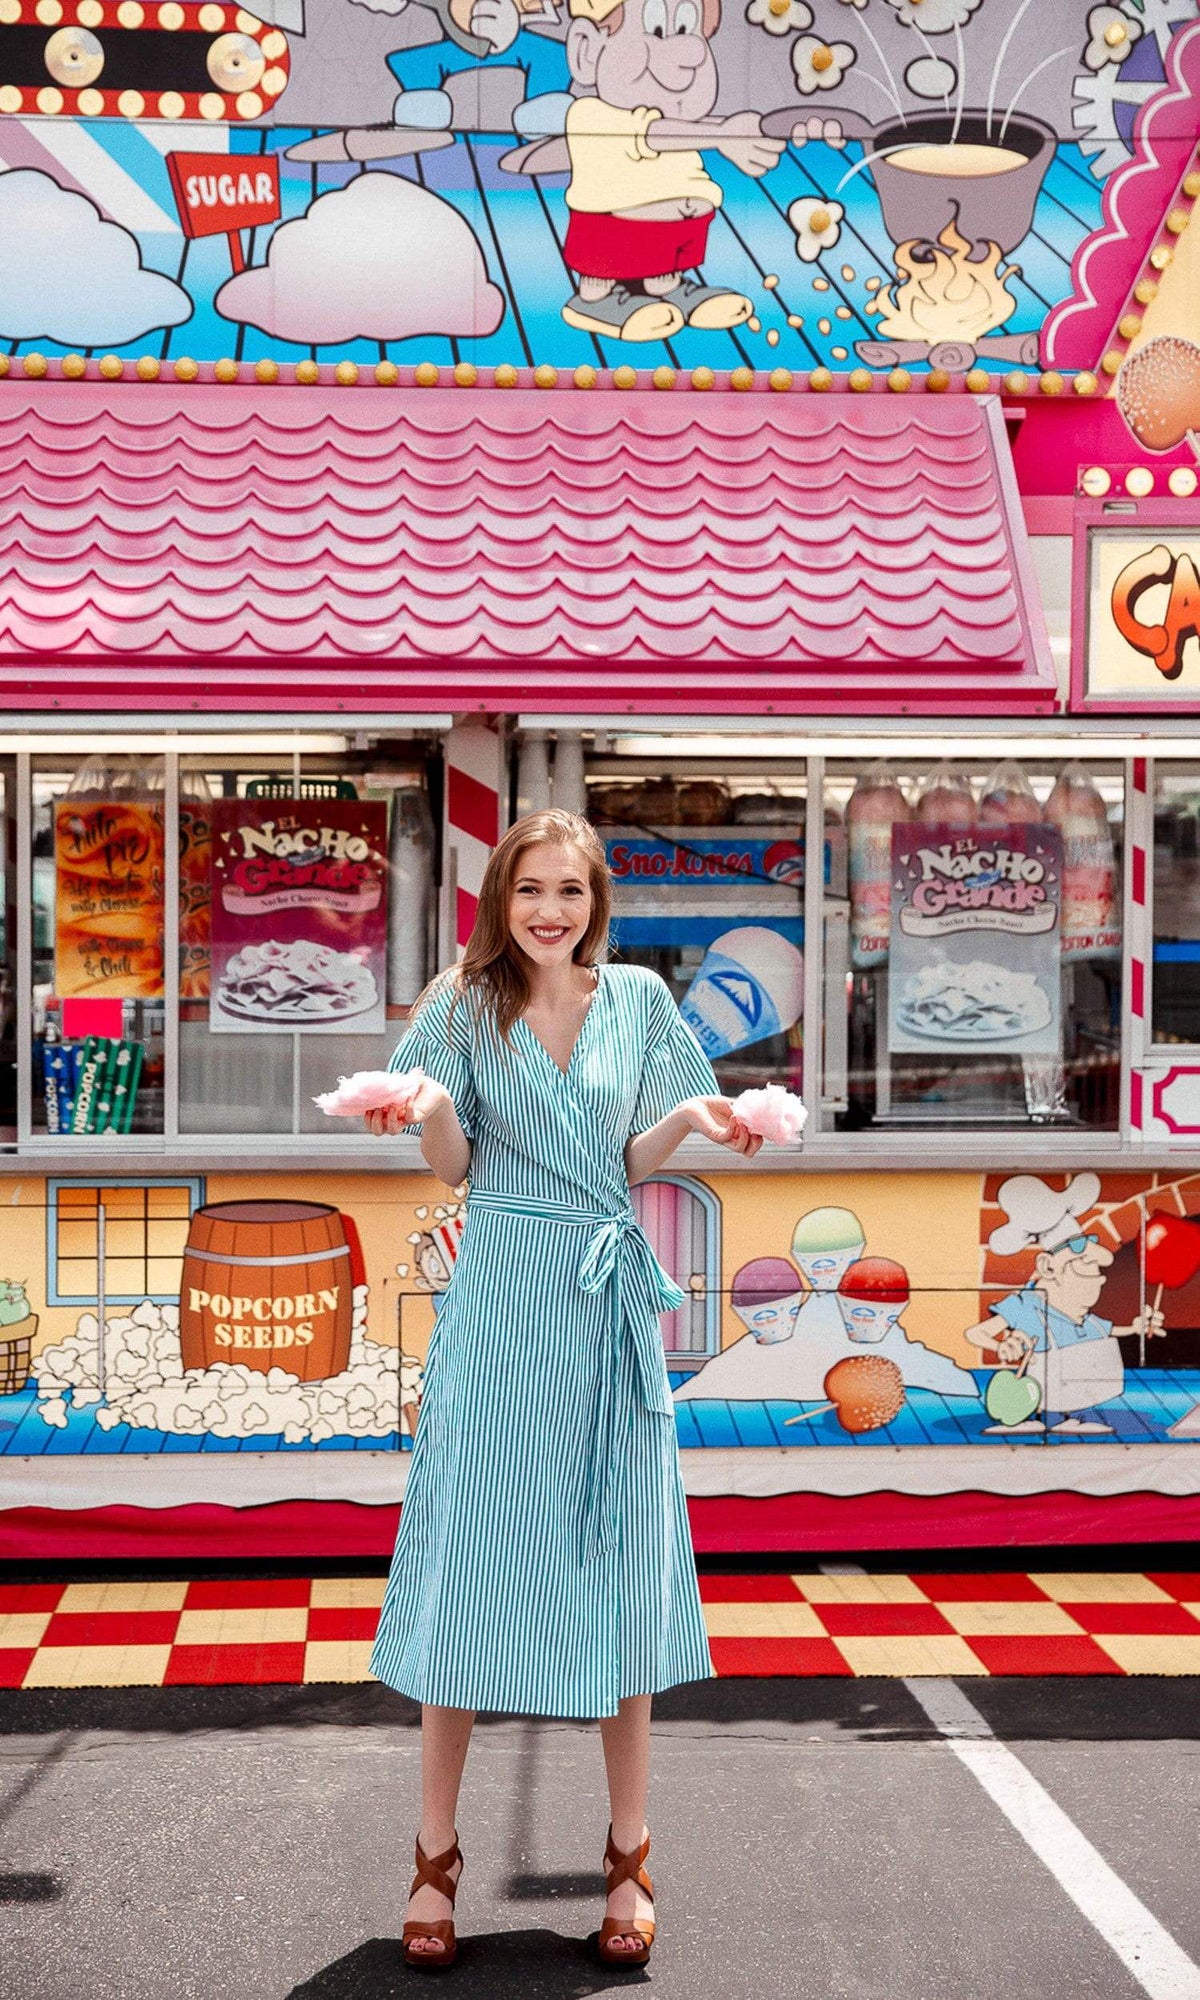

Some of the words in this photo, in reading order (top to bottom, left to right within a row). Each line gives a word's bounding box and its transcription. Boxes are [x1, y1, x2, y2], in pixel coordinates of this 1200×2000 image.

[186, 172, 275, 208] SUGAR
[277, 816, 300, 830] EL
[956, 838, 978, 852] EL
[234, 858, 370, 893] Grande
[912, 878, 1046, 915] Grande
[73, 1062, 97, 1133] POPCORN
[188, 1286, 340, 1321] POPCORN
[214, 1322, 315, 1349] SEEDS
